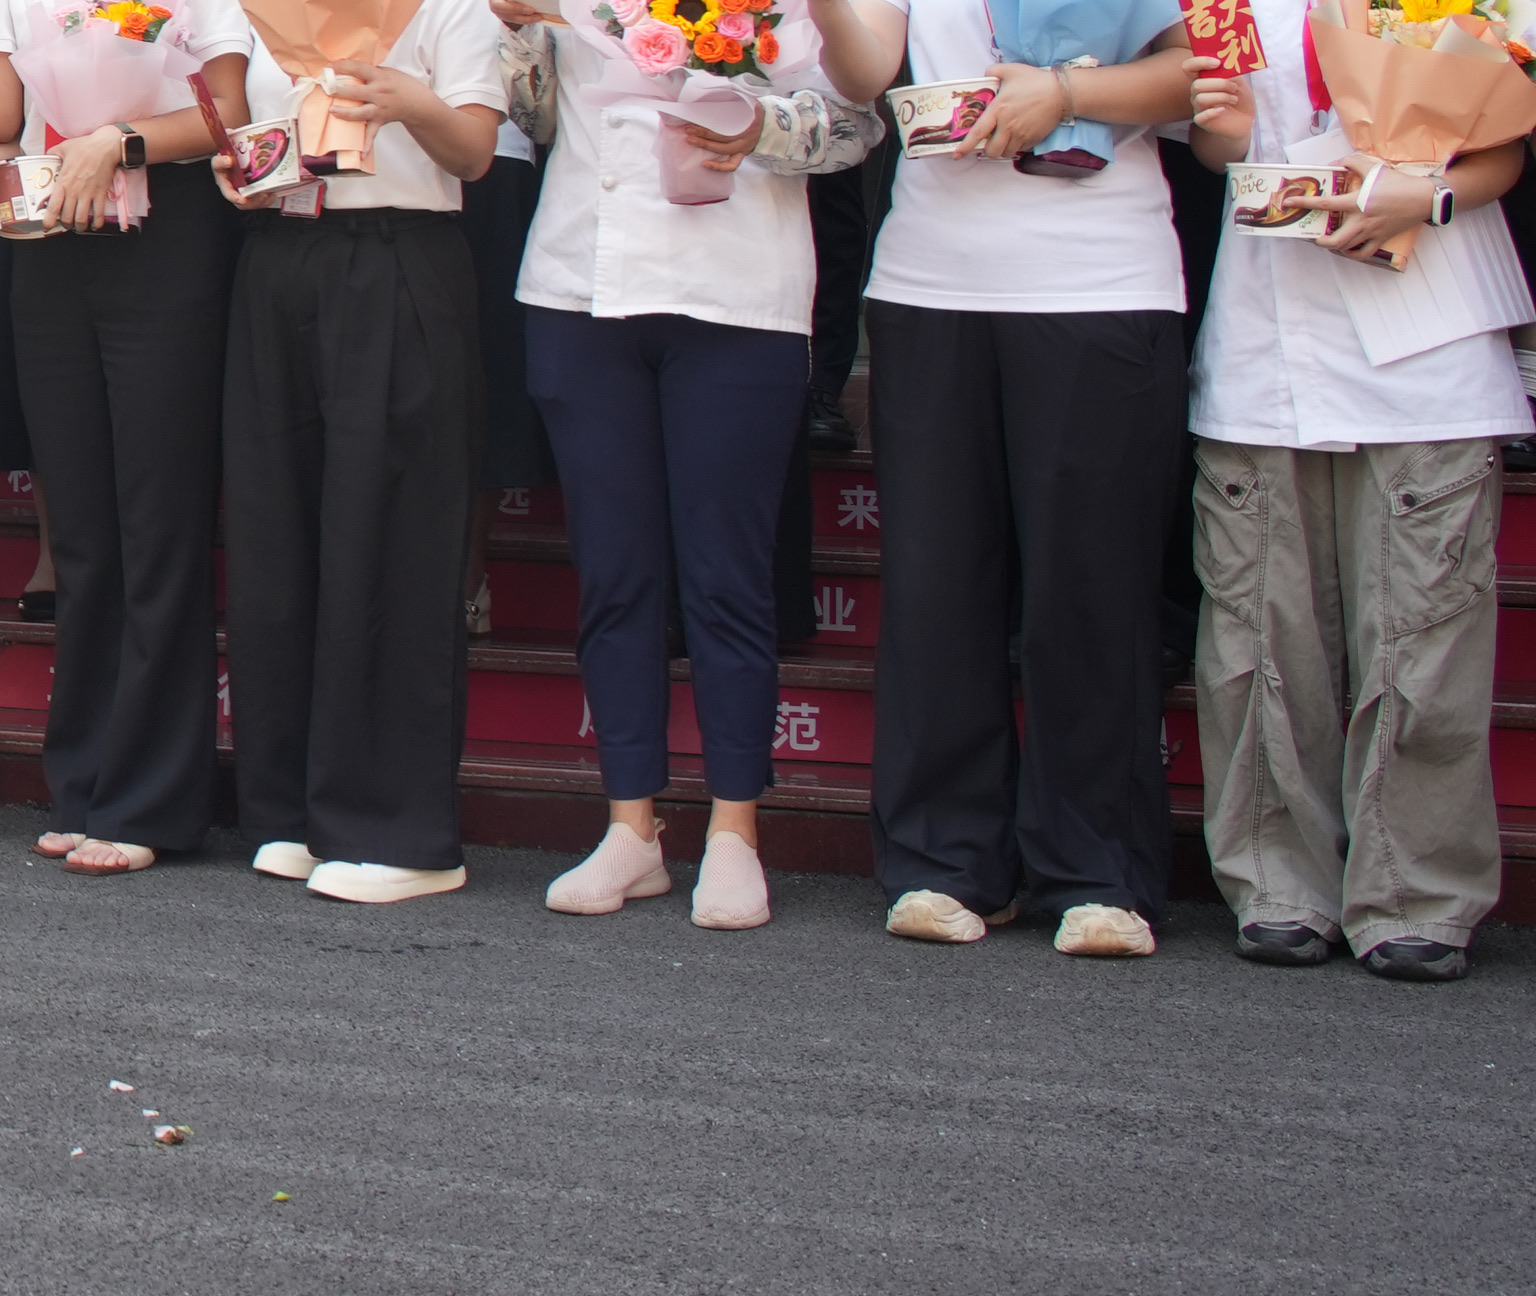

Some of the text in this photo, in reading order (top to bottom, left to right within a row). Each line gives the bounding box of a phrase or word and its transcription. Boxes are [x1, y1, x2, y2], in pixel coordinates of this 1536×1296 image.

[895, 93, 949, 126] Dove
[837, 485, 880, 530] 来
[814, 586, 857, 633] 业
[772, 701, 821, 751] 范
